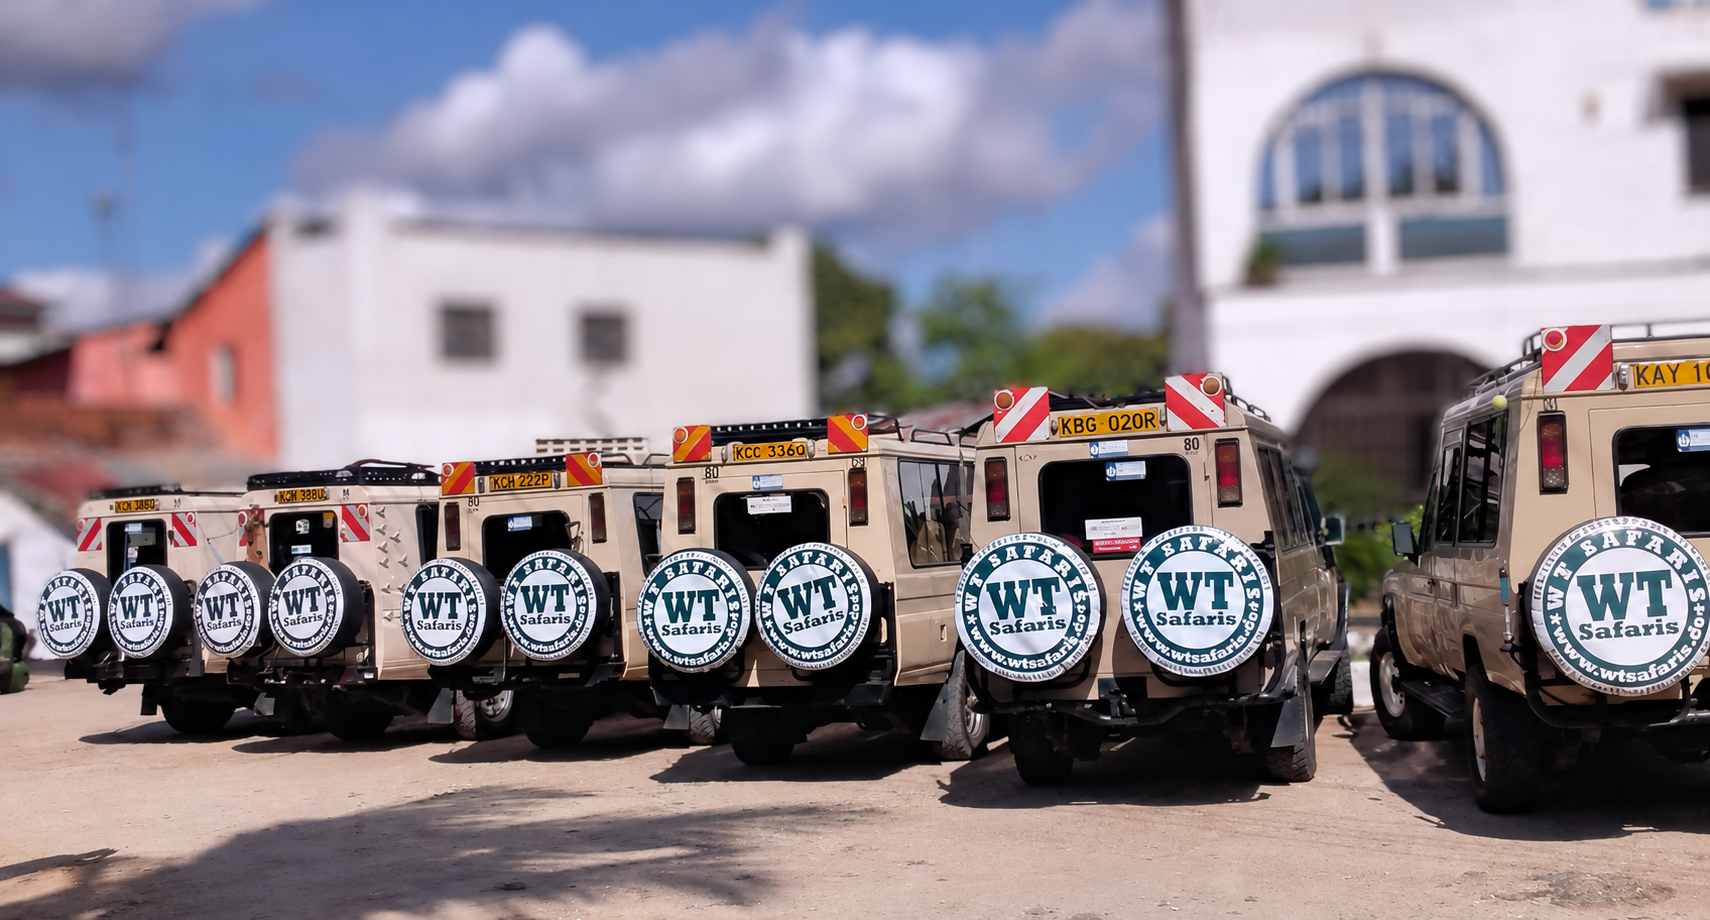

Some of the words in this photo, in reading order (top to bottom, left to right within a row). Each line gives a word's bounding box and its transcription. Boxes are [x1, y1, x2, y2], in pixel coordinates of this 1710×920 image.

[1636, 363, 1680, 386] KAY
[1061, 417, 1097, 435] KBG
[1108, 412, 1156, 431] 020R
[736, 446, 761, 460] KCC
[1184, 437, 1200, 451] 80
[493, 475, 515, 490] KCH
[518, 473, 549, 487] 222P
[705, 466, 719, 479] 80
[468, 496, 480, 507] 80
[505, 577, 520, 606] WT
[964, 572, 983, 612] WT
[1132, 560, 1155, 600] WT
[1157, 571, 1234, 611] WT
[1547, 561, 1573, 610] WT
[120, 593, 153, 620] WT
[205, 592, 240, 621] WT
[282, 585, 321, 616] WT
[403, 585, 417, 611] WT
[417, 592, 462, 620] WT
[520, 583, 569, 614] WT
[643, 582, 660, 616] WT
[661, 589, 720, 624] WT
[761, 583, 775, 618] WT
[776, 574, 837, 620] WT
[986, 576, 1060, 621] WT
[1576, 569, 1673, 621] WT
[47, 594, 80, 623] WT
[283, 613, 324, 627] Safaris
[520, 613, 571, 625] Safaris
[1156, 611, 1237, 626] Safaris
[49, 620, 82, 633] Safaris
[120, 618, 154, 630] Safaris
[207, 618, 242, 632] Safaris
[417, 620, 462, 631] Safaris
[661, 622, 722, 637] Safaris
[783, 610, 845, 635] Safaris
[989, 616, 1066, 636] Safaris
[1578, 618, 1680, 641] Safaris
